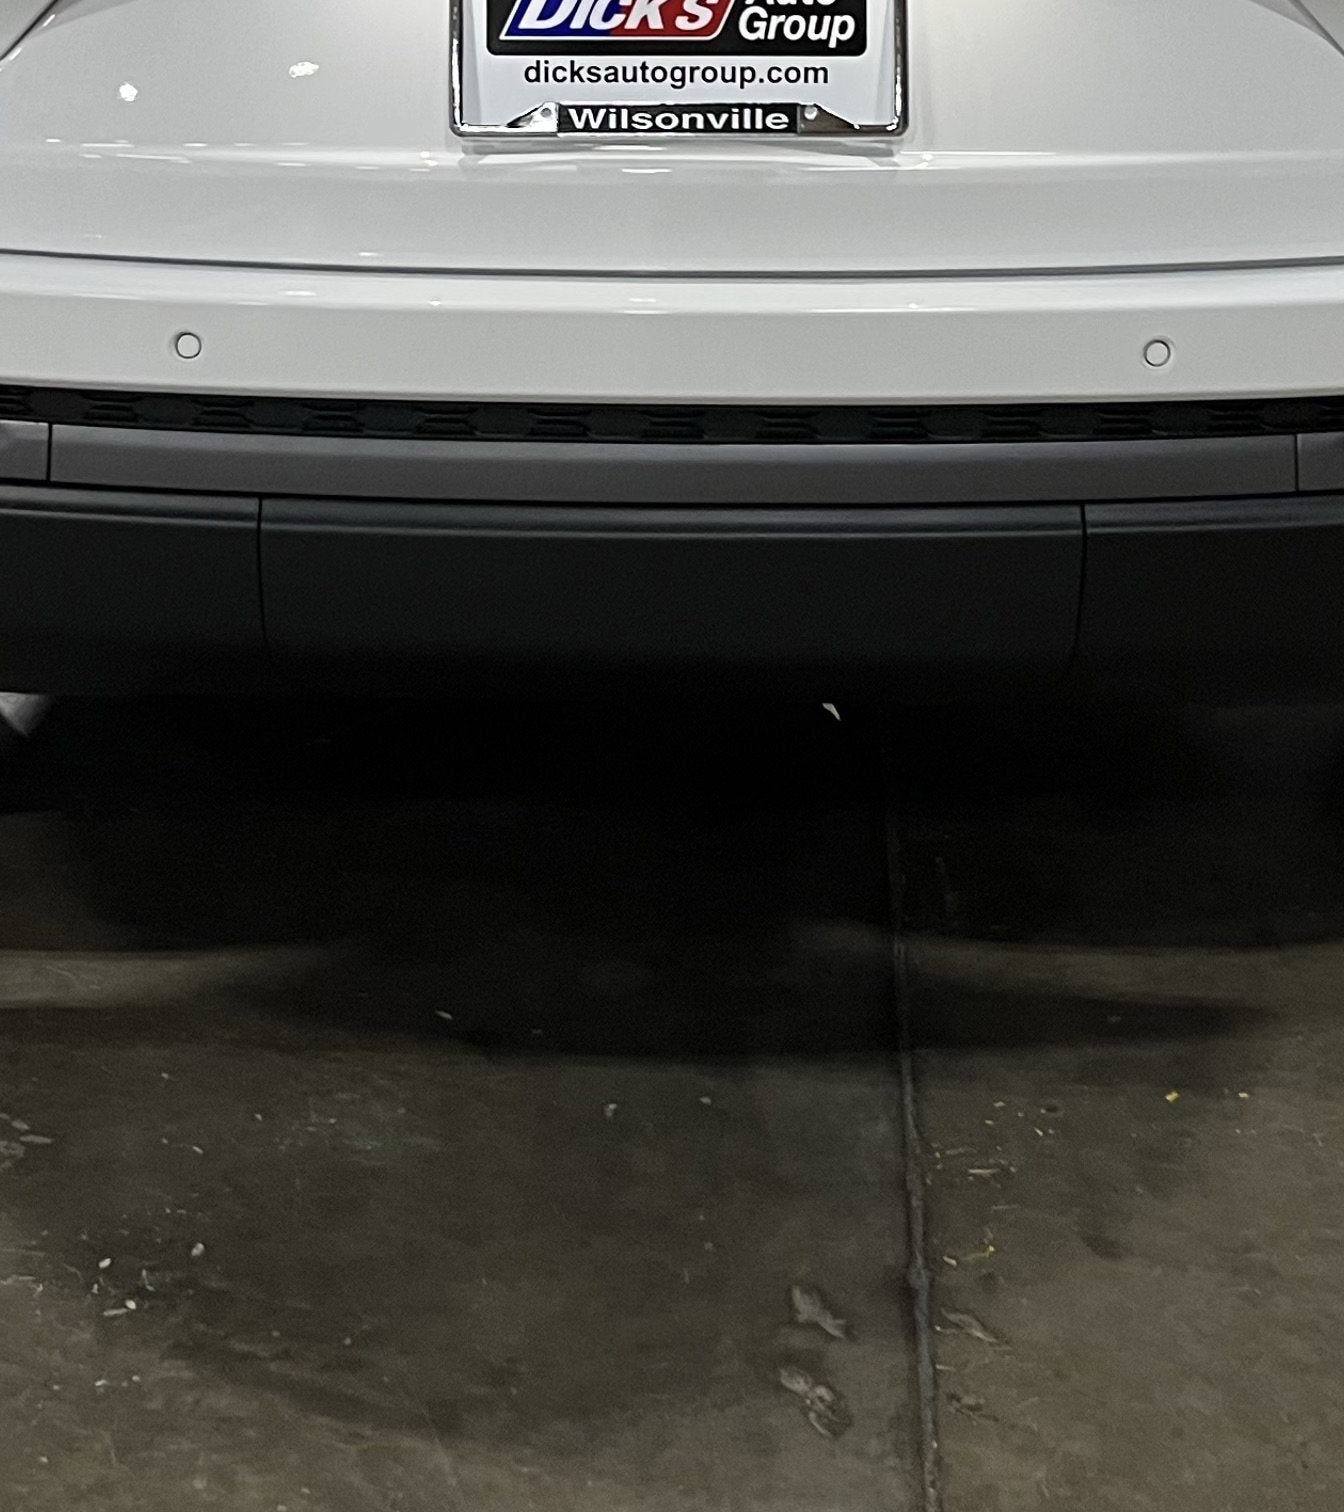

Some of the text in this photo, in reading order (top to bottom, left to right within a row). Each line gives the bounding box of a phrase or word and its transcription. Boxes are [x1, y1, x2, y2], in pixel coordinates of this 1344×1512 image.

[738, 6, 856, 48] Group
[523, 60, 829, 88] dicksautogroup.com
[567, 106, 790, 130] Wilsonville
